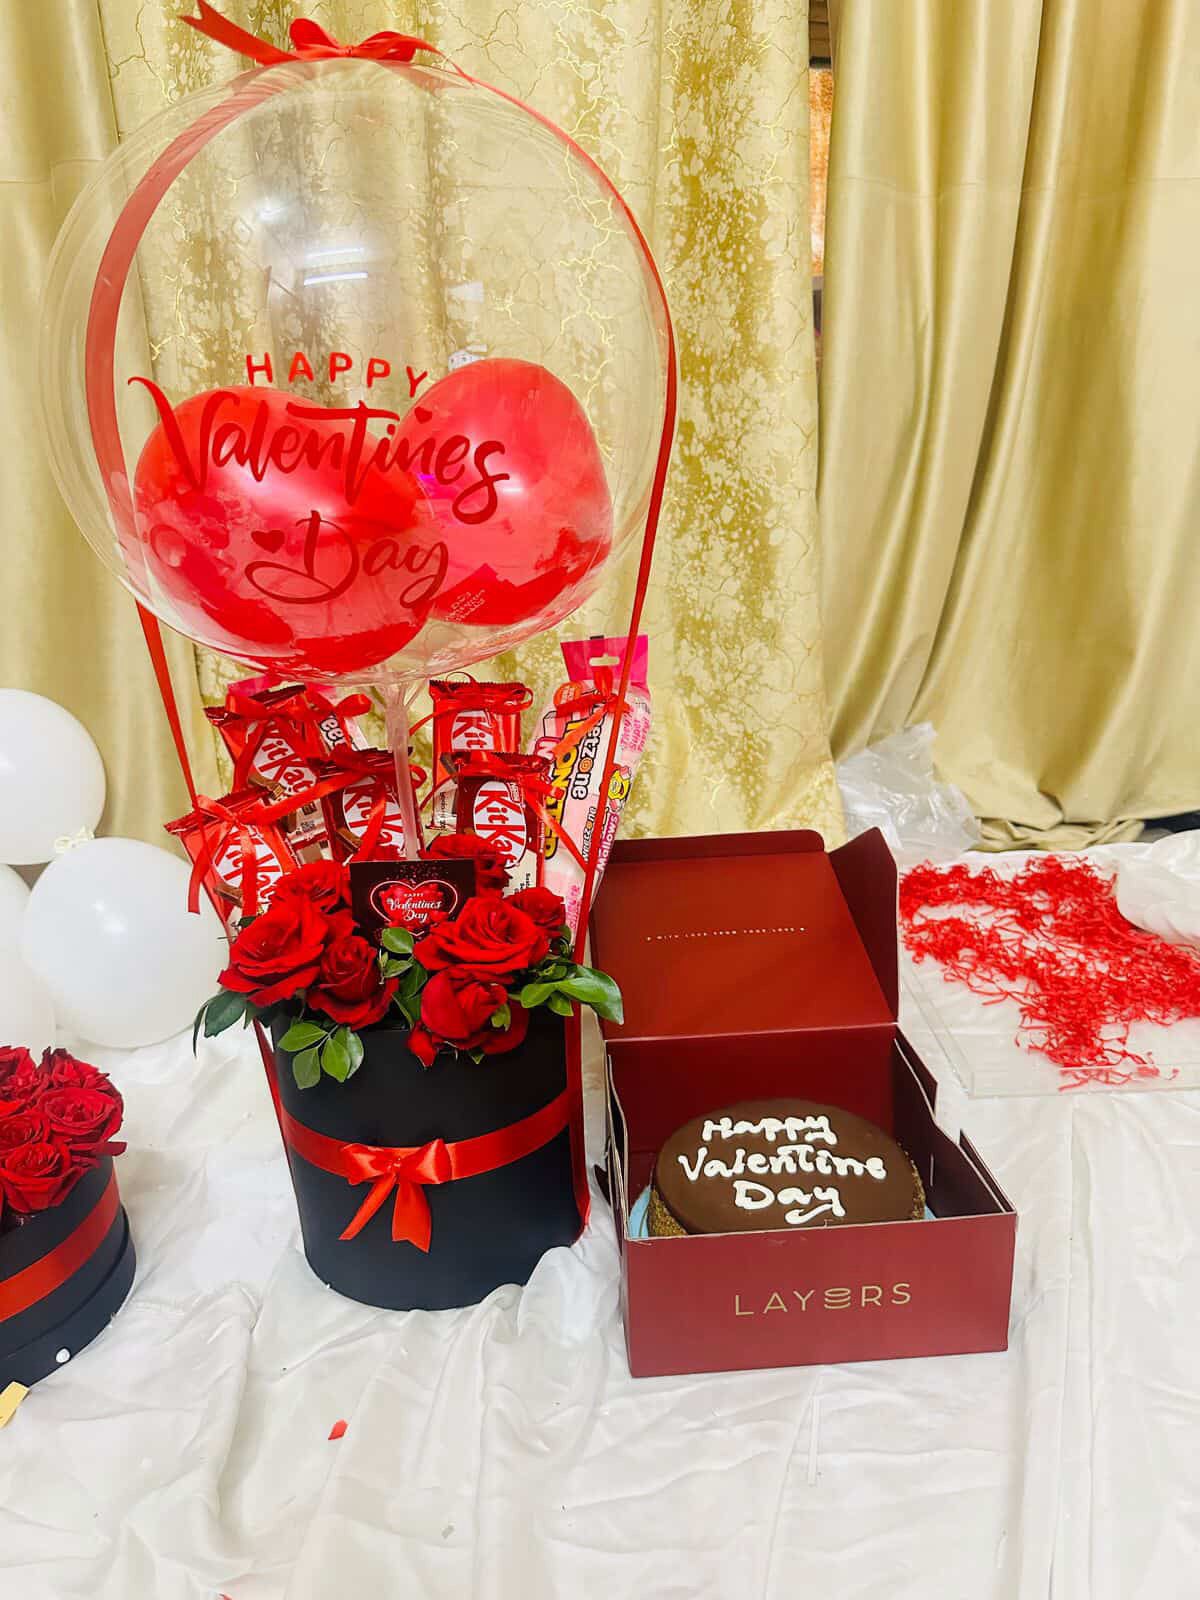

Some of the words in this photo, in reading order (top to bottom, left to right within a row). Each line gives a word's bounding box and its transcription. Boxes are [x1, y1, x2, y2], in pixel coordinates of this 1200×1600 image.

[245, 351, 428, 398] HAPPY
[127, 376, 510, 525] Valentines
[244, 510, 449, 608] Day
[403, 909, 428, 924] Day
[701, 1114, 838, 1146] Happy
[677, 1144, 887, 1182] Valentine
[732, 1180, 847, 1225] Day
